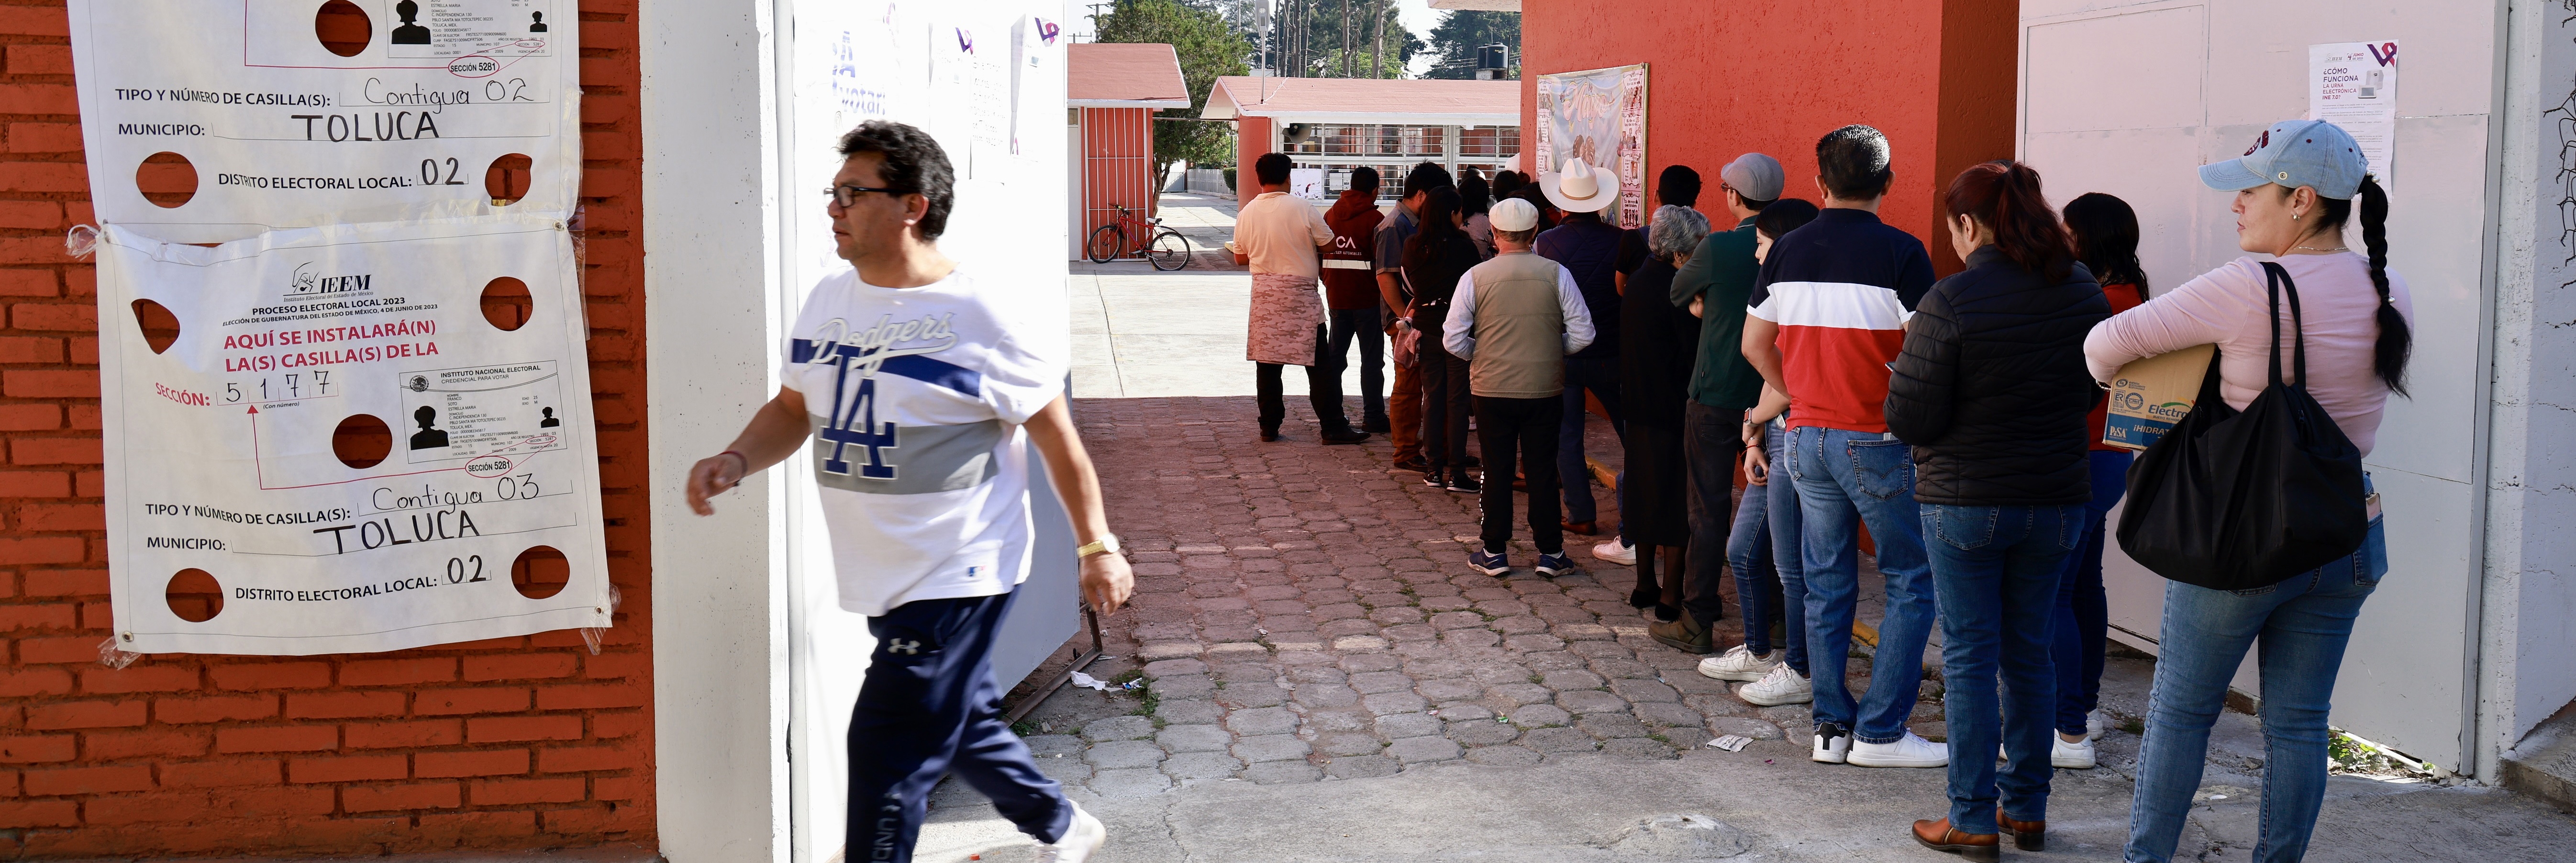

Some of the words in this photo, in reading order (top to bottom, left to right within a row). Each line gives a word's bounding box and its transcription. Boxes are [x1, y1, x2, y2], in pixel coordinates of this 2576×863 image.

[451, 63, 477, 72] SECCIÓN
[479, 62, 495, 71] 5281
[2323, 67, 2348, 75] ¿CÓMO
[115, 89, 152, 101] TIPO
[156, 90, 166, 101] Y
[170, 87, 219, 104] NÚMERO
[223, 92, 242, 104] DE
[246, 93, 330, 108] CASILLA(S):
[365, 78, 470, 114] Contigua
[118, 123, 205, 136] MUNICIPIO:
[291, 111, 439, 143] TOLUCA
[219, 173, 268, 188] DISTRITO
[272, 177, 354, 189] ELECTORAL
[358, 176, 412, 189] LOCAL:
[319, 274, 371, 293] IEEM
[252, 305, 297, 315] PROCESO
[300, 302, 349, 312] ELECTORAL
[351, 299, 381, 308] LOCAL
[383, 297, 405, 305] 2023
[222, 317, 250, 326] ELECCIÓN
[261, 314, 308, 323] GUBERNATURA
[223, 329, 274, 350] AQUÍ
[279, 330, 302, 345] SE
[307, 318, 436, 343] INSTALARÁ(N)
[804, 312, 958, 377] Dodgers
[225, 354, 276, 373] LA(S)
[281, 345, 381, 368] CASILLA(S)
[386, 344, 411, 359] DE
[415, 341, 439, 356] LA
[155, 382, 210, 406] SECCIÓN:
[818, 343, 899, 480] LA
[468, 462, 492, 471] SECCIÓN
[494, 460, 510, 470] 5281
[373, 484, 483, 515] Contigua
[145, 504, 178, 516] TIPO
[182, 505, 191, 516] Y
[194, 505, 242, 524] NÚMERO
[245, 514, 263, 525] DE
[266, 508, 351, 525] CASILLA(S):
[313, 510, 480, 554] TOLUCA
[147, 537, 226, 551] MUNICIPIO:
[235, 587, 294, 601] DISTRITO
[298, 584, 381, 601] ELECTORAL
[385, 576, 437, 593] LOCAL:
[872, 818, 899, 863] UND
